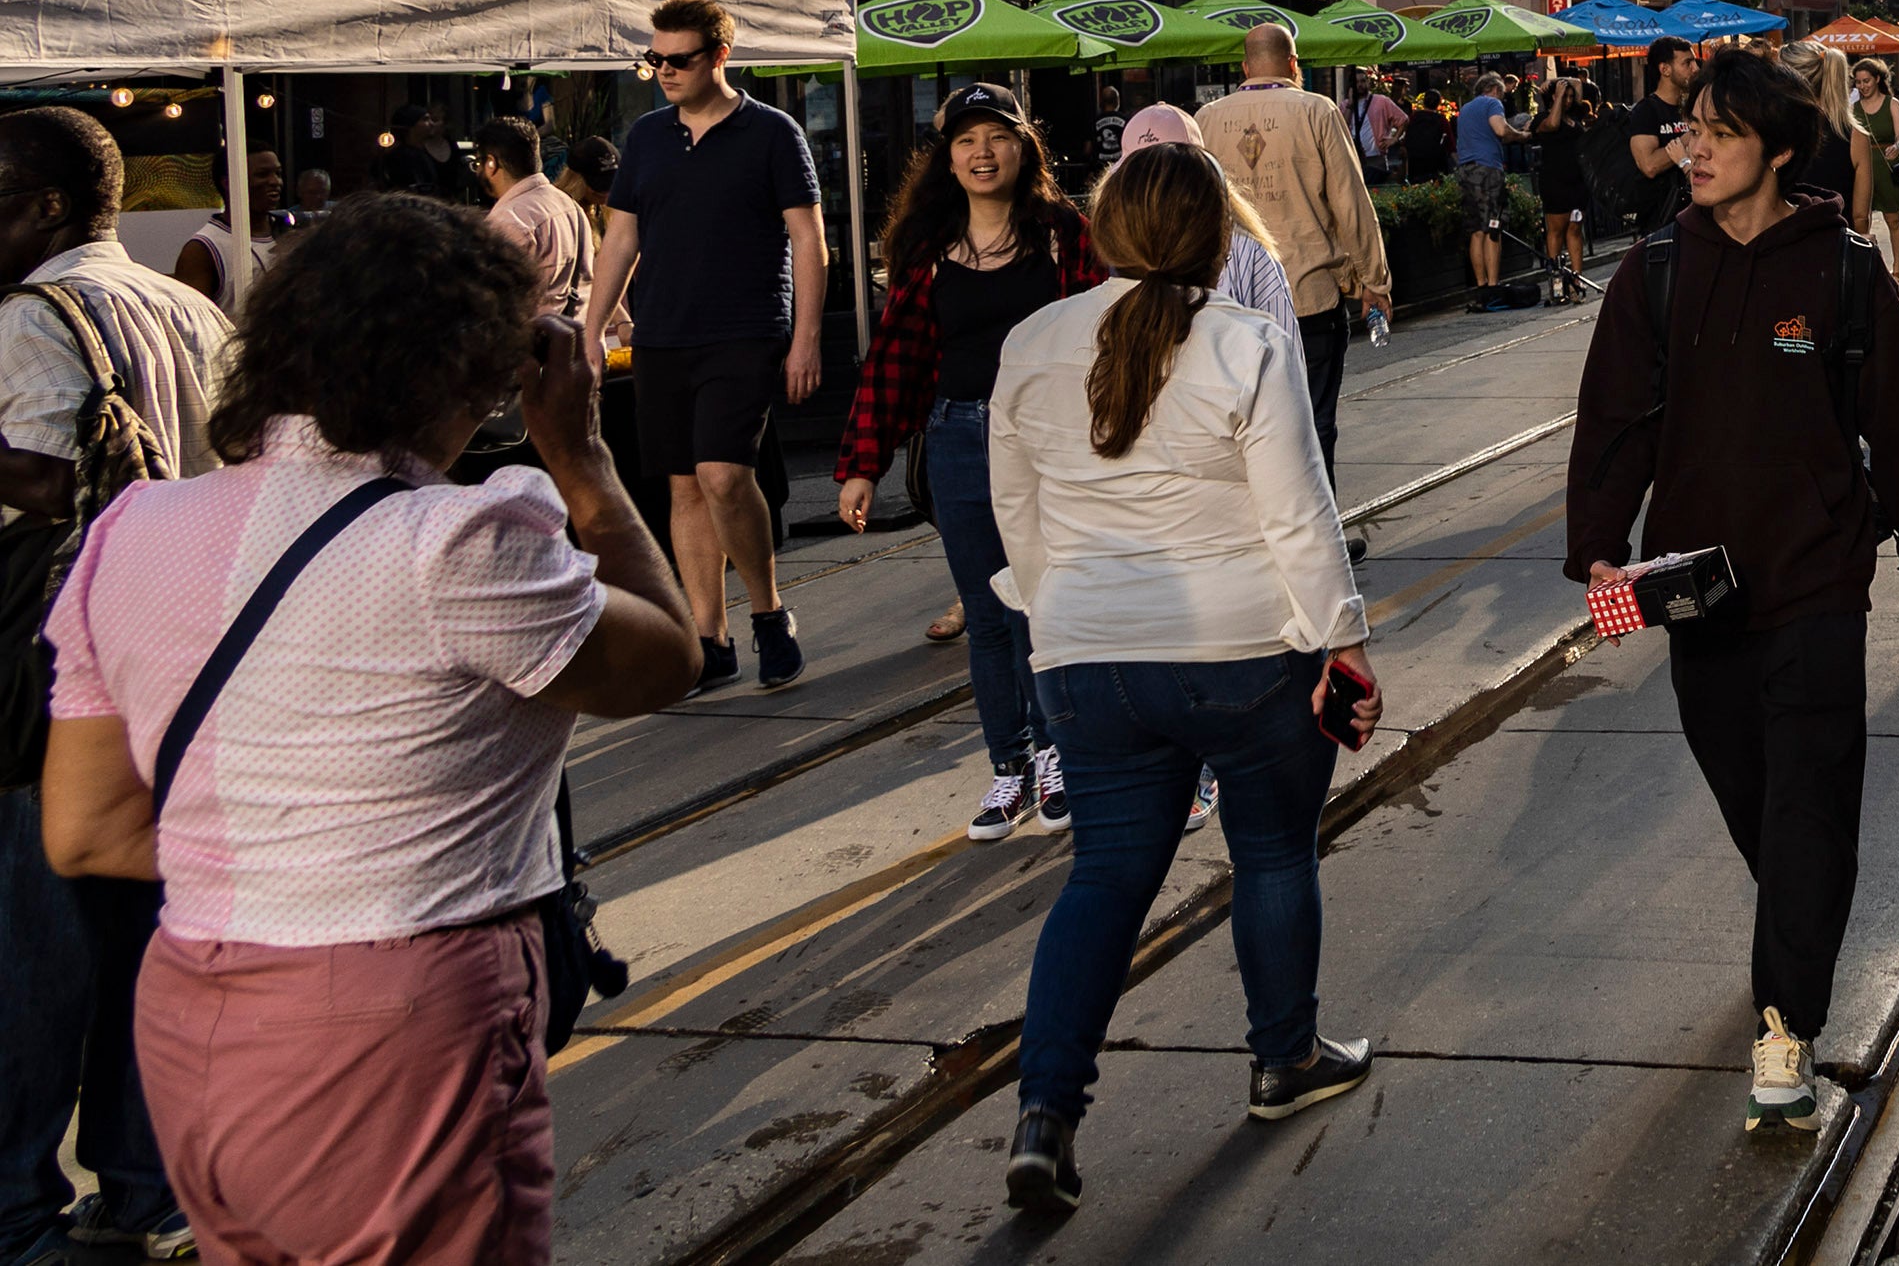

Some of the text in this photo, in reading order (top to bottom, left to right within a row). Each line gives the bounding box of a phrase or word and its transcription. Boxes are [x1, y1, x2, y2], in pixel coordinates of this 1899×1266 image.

[876, 0, 971, 29] HOP
[1070, 4, 1145, 27] HOP
[1594, 12, 1662, 31] Coors
[1680, 11, 1742, 25] Coors
[890, 16, 964, 35] VALLEY
[1082, 19, 1151, 36] VALLEY
[1599, 27, 1665, 37] SELTZER
[1811, 32, 1879, 44] VIZZY
[1842, 44, 1876, 52] SELTZER
